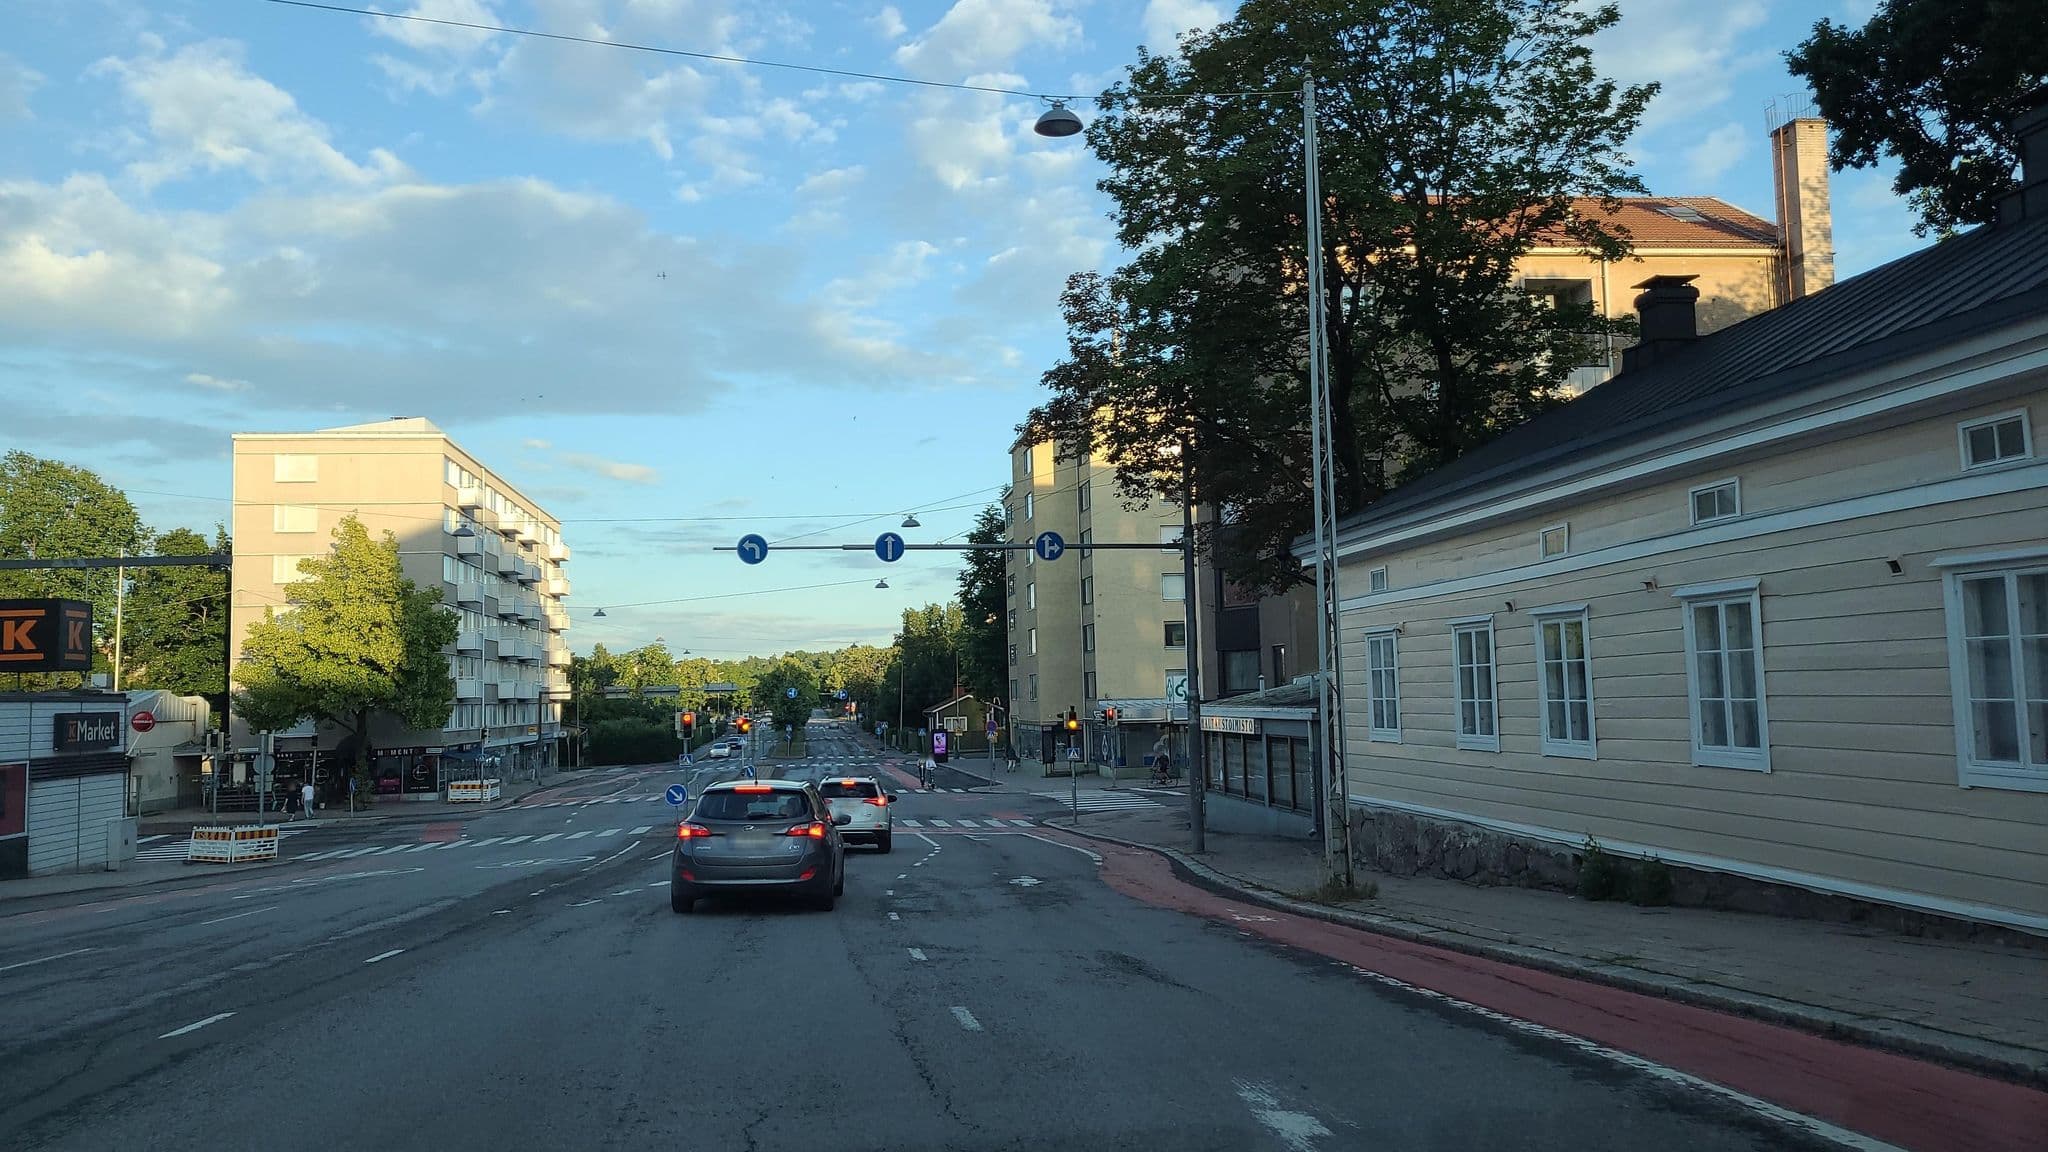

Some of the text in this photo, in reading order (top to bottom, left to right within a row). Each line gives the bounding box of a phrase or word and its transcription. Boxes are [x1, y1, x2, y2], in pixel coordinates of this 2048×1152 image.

[3, 620, 37, 650] K
[68, 621, 83, 650] K
[77, 718, 115, 742] Market
